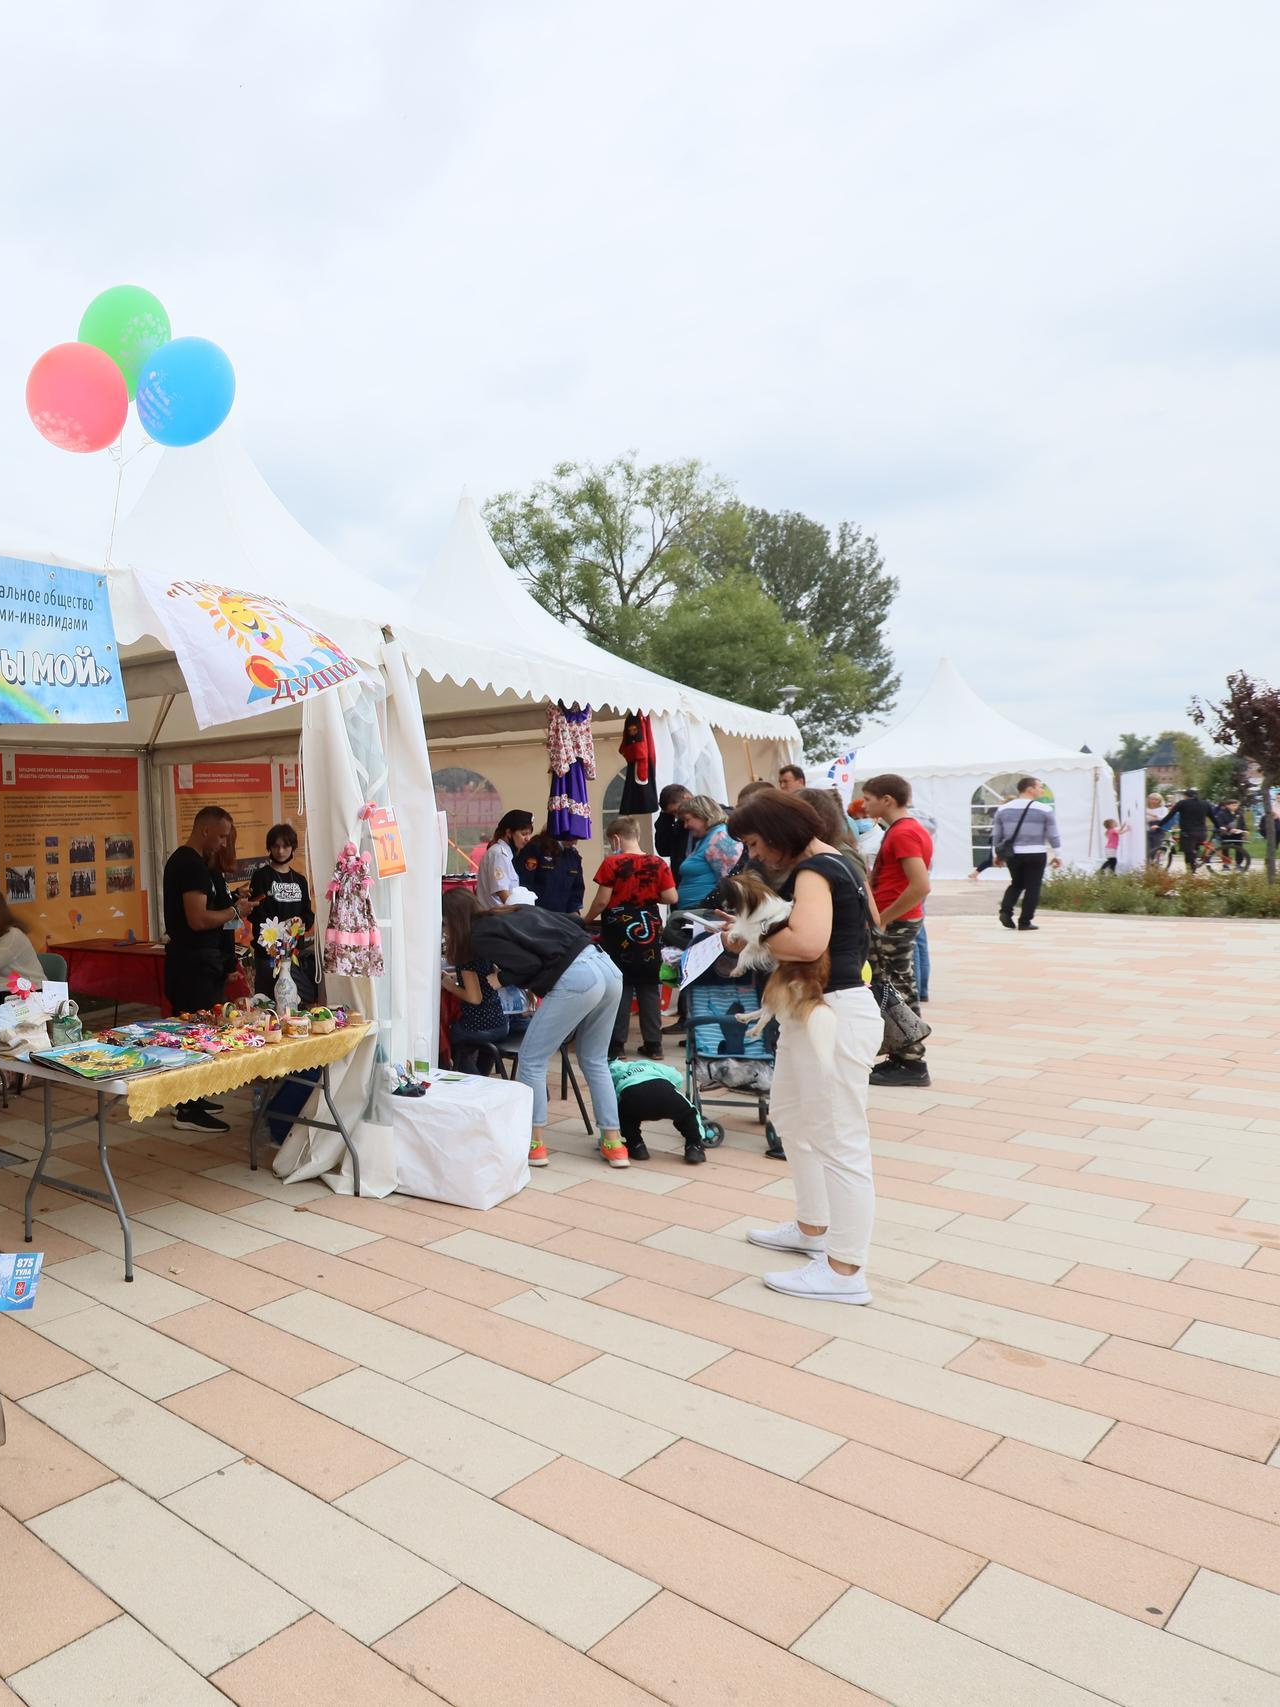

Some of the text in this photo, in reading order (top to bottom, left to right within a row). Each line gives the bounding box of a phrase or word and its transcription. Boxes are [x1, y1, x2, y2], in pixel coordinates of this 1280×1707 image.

[44, 588, 94, 611] общество
[32, 645, 113, 687] МОЙ»
[16, 1257, 35, 1268] 875
